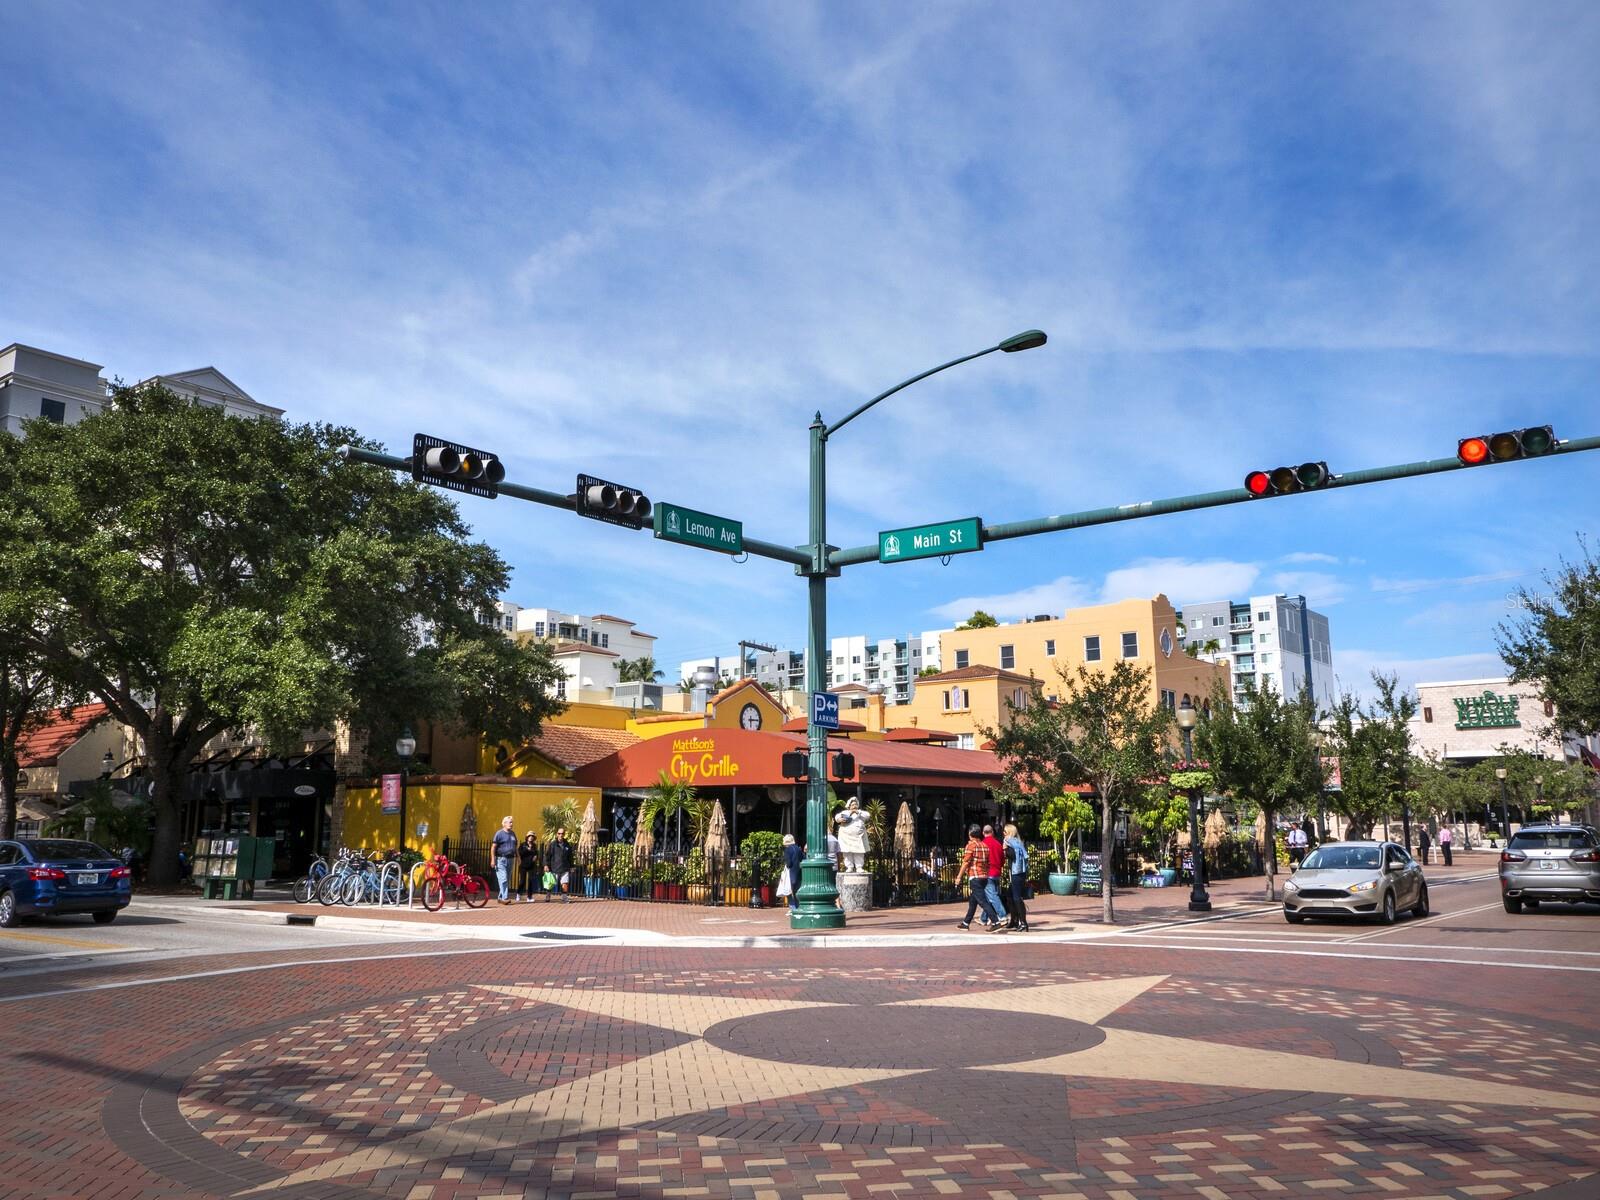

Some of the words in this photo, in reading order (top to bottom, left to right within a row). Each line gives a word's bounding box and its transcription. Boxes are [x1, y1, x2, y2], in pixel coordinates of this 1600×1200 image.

[685, 518, 715, 540] Lemon
[720, 527, 736, 544] Ave
[913, 533, 940, 549] Main
[949, 529, 963, 544] St
[1452, 693, 1520, 711] WHOLE
[672, 737, 715, 750] Mattison's
[671, 754, 698, 783] City
[700, 753, 740, 778] Grille
